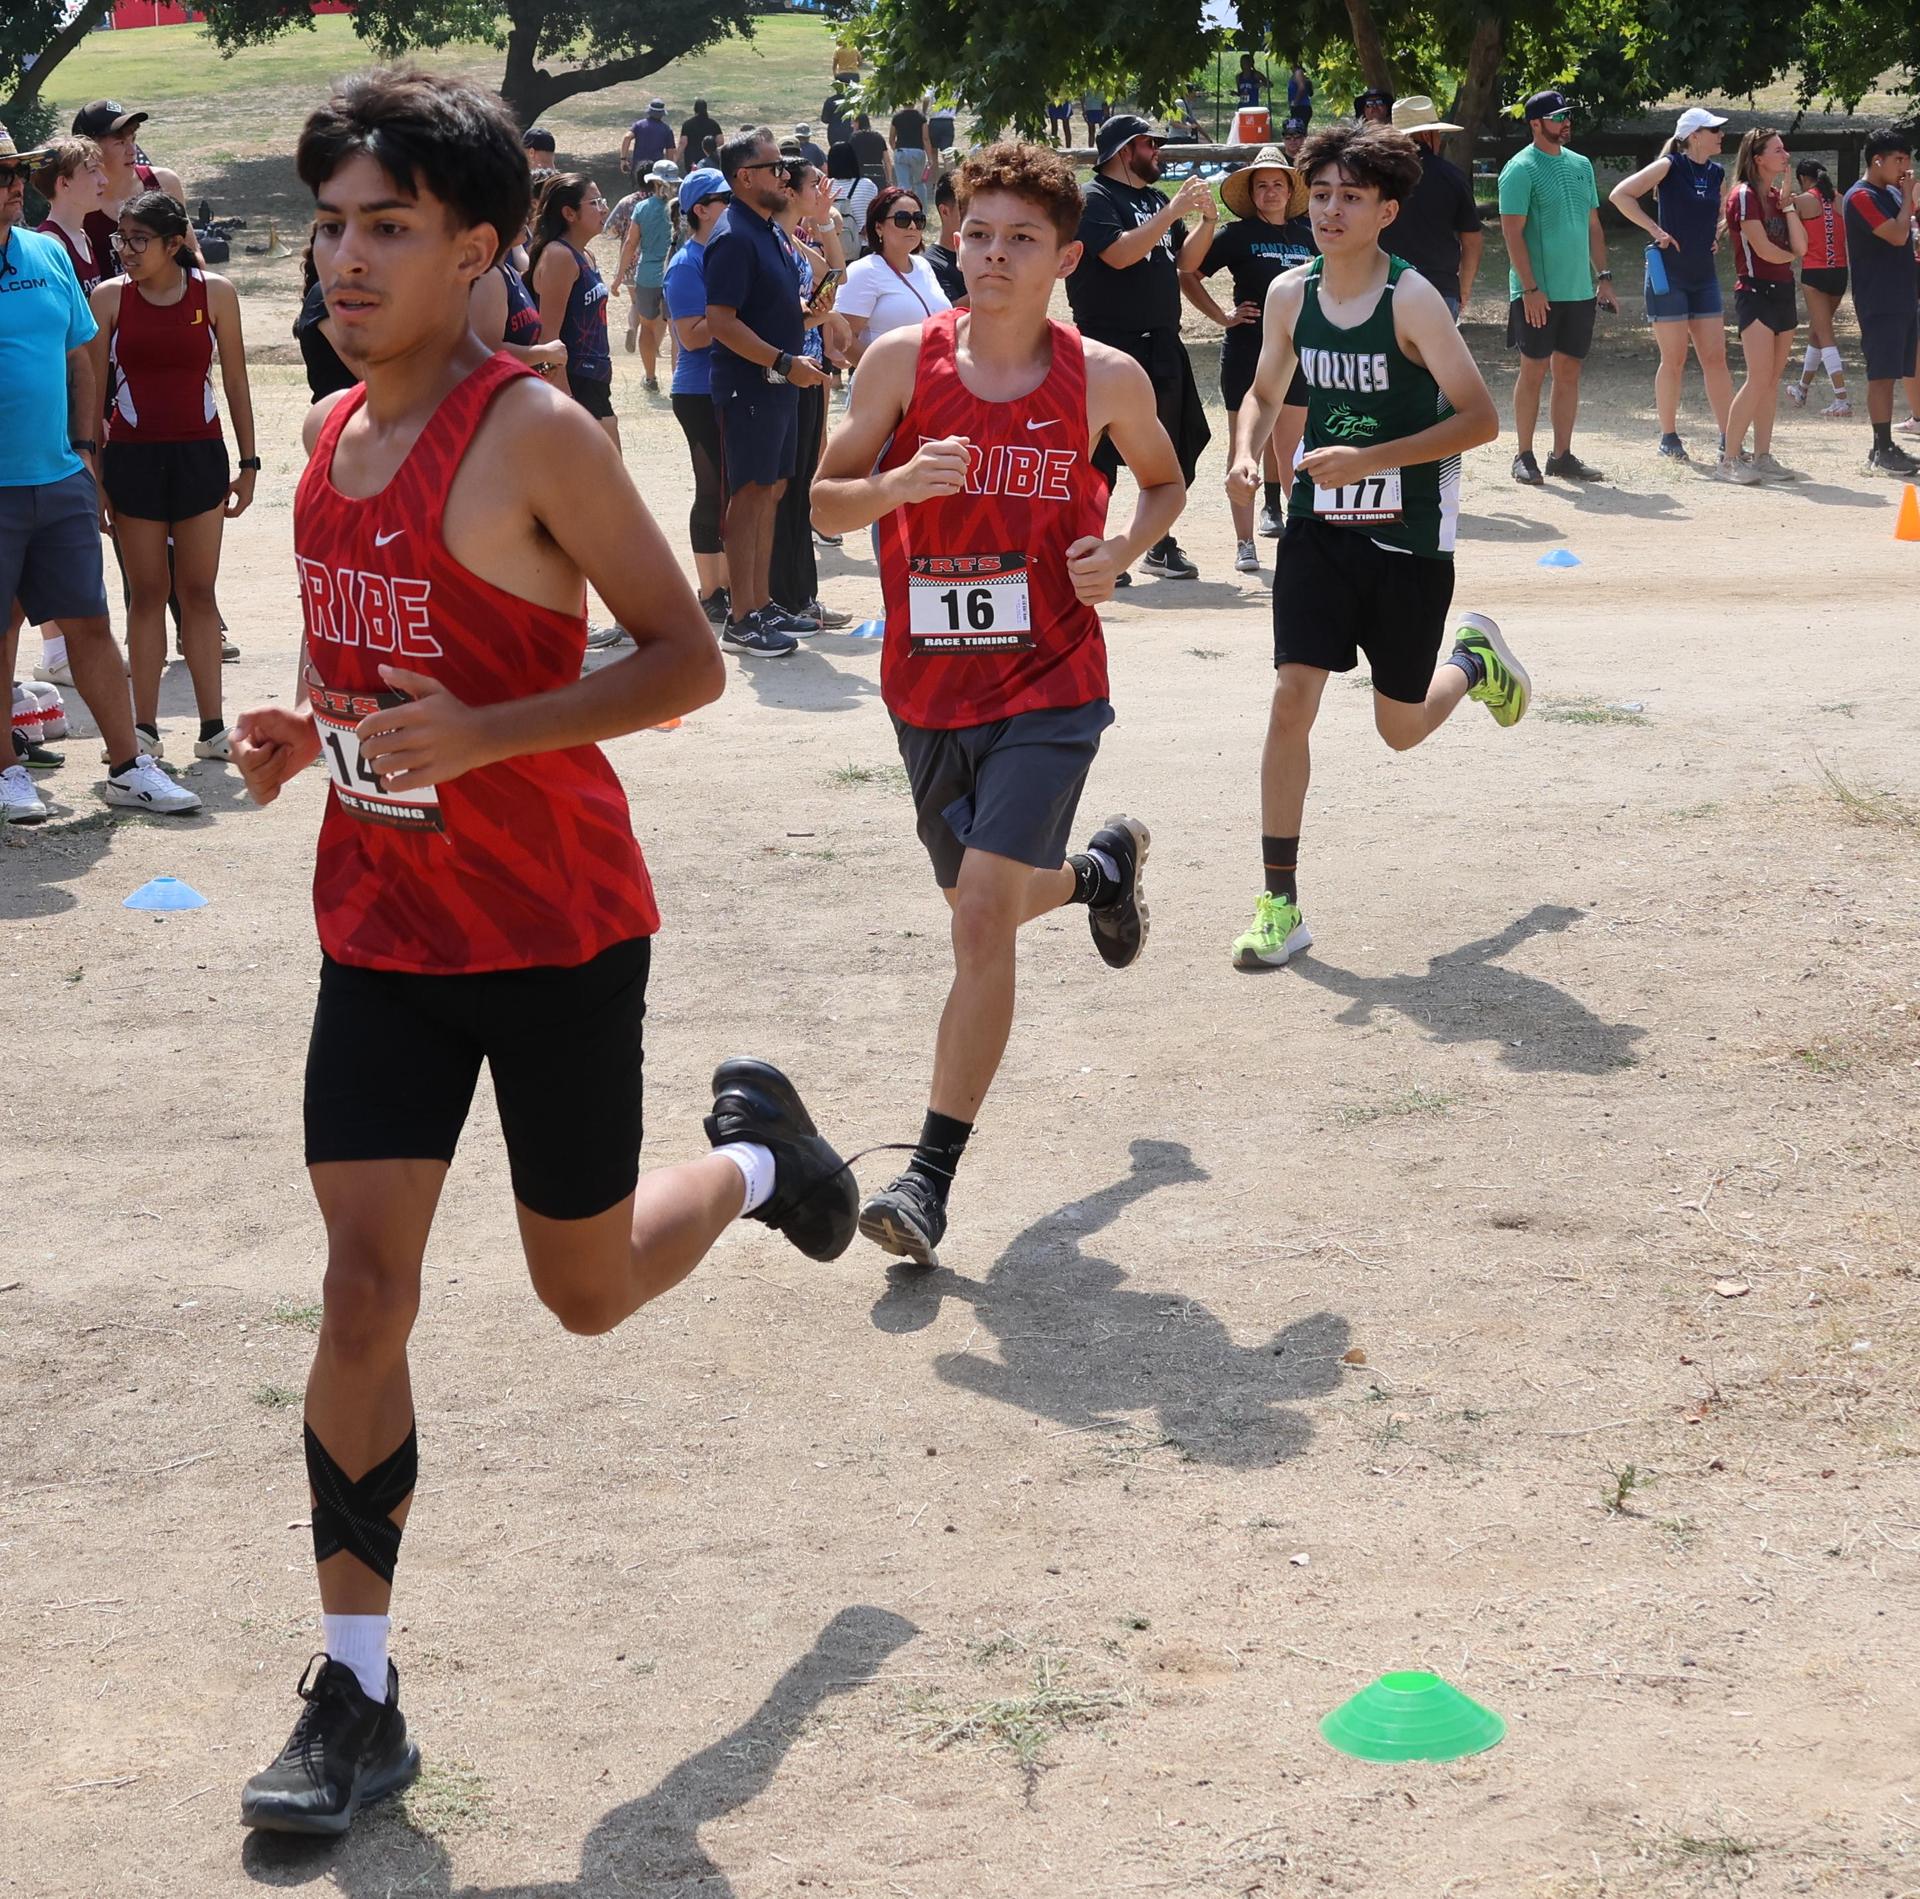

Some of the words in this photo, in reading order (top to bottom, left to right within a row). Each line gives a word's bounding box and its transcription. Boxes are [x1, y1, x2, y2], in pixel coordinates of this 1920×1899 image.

[1300, 346, 1389, 393] WOLVES
[919, 435, 1077, 500] RIBE
[1324, 513, 1354, 521] RACE
[1355, 512, 1395, 521] TIMING
[929, 556, 1002, 573] RTS
[940, 588, 995, 630] 16
[924, 637, 961, 647] RACE
[963, 635, 1019, 646] TIMING
[360, 799, 425, 819] TIMING
